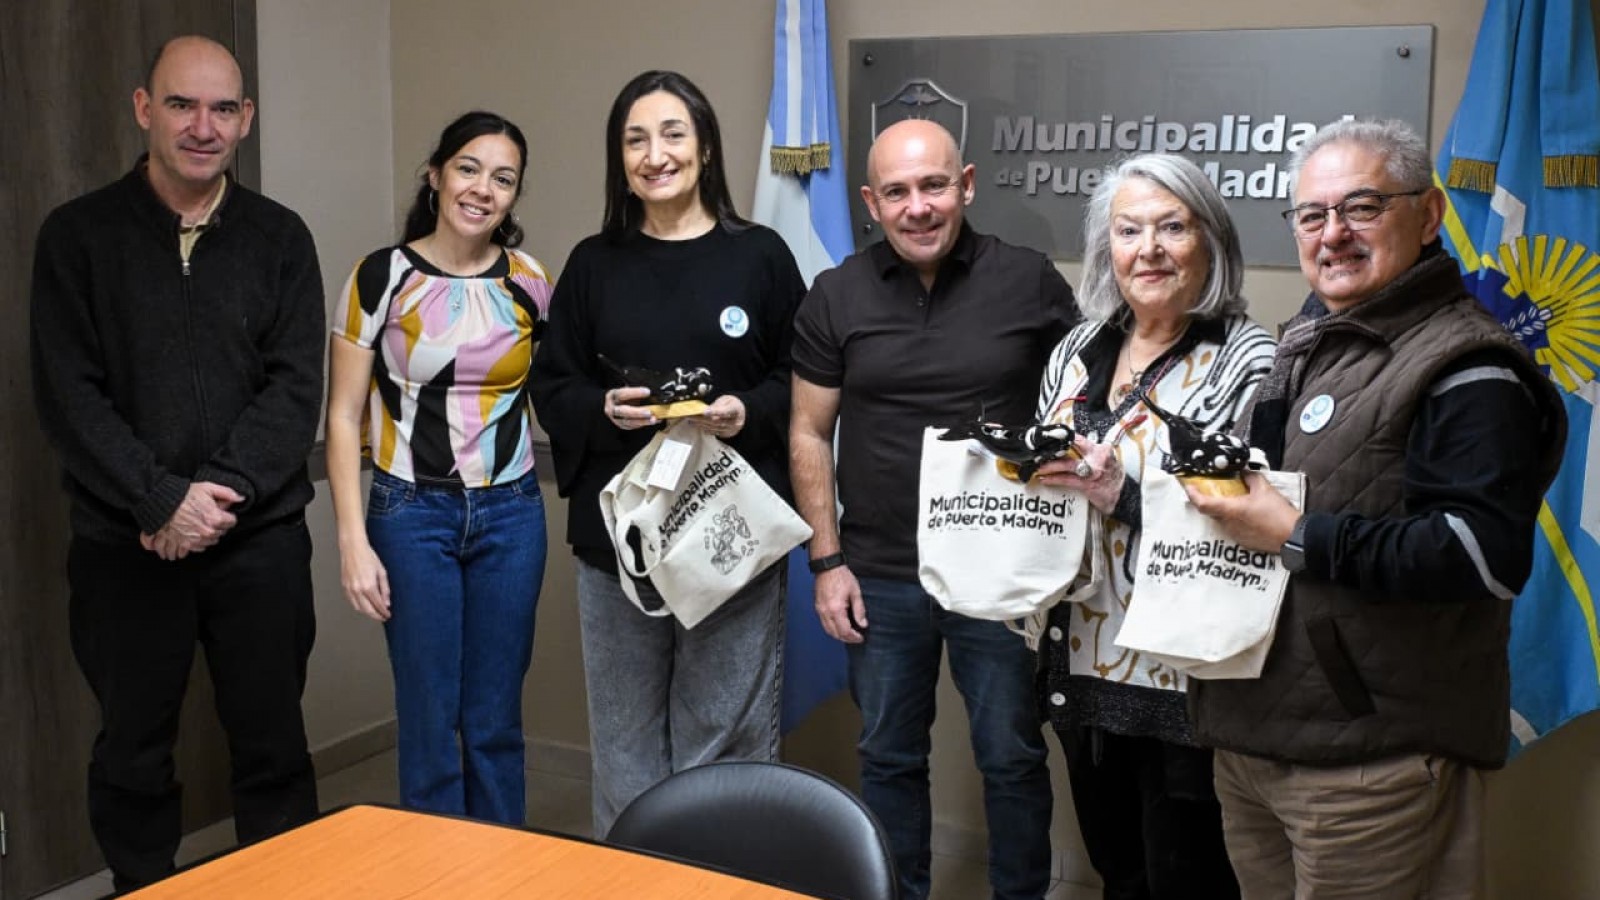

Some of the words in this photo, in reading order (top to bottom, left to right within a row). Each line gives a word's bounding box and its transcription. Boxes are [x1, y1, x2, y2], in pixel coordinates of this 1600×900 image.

[992, 114, 1355, 154] Municipalida
[995, 167, 1024, 186] de
[1026, 160, 1102, 196] Pue
[659, 451, 733, 533] unicipalidad
[698, 467, 741, 502] Madryn
[929, 490, 1067, 519] Municipalidad
[928, 514, 943, 529] de
[945, 511, 997, 526] Puerto
[1002, 513, 1064, 536] Madryn
[1146, 560, 1161, 576] de
[1196, 560, 1261, 588] Madryn
